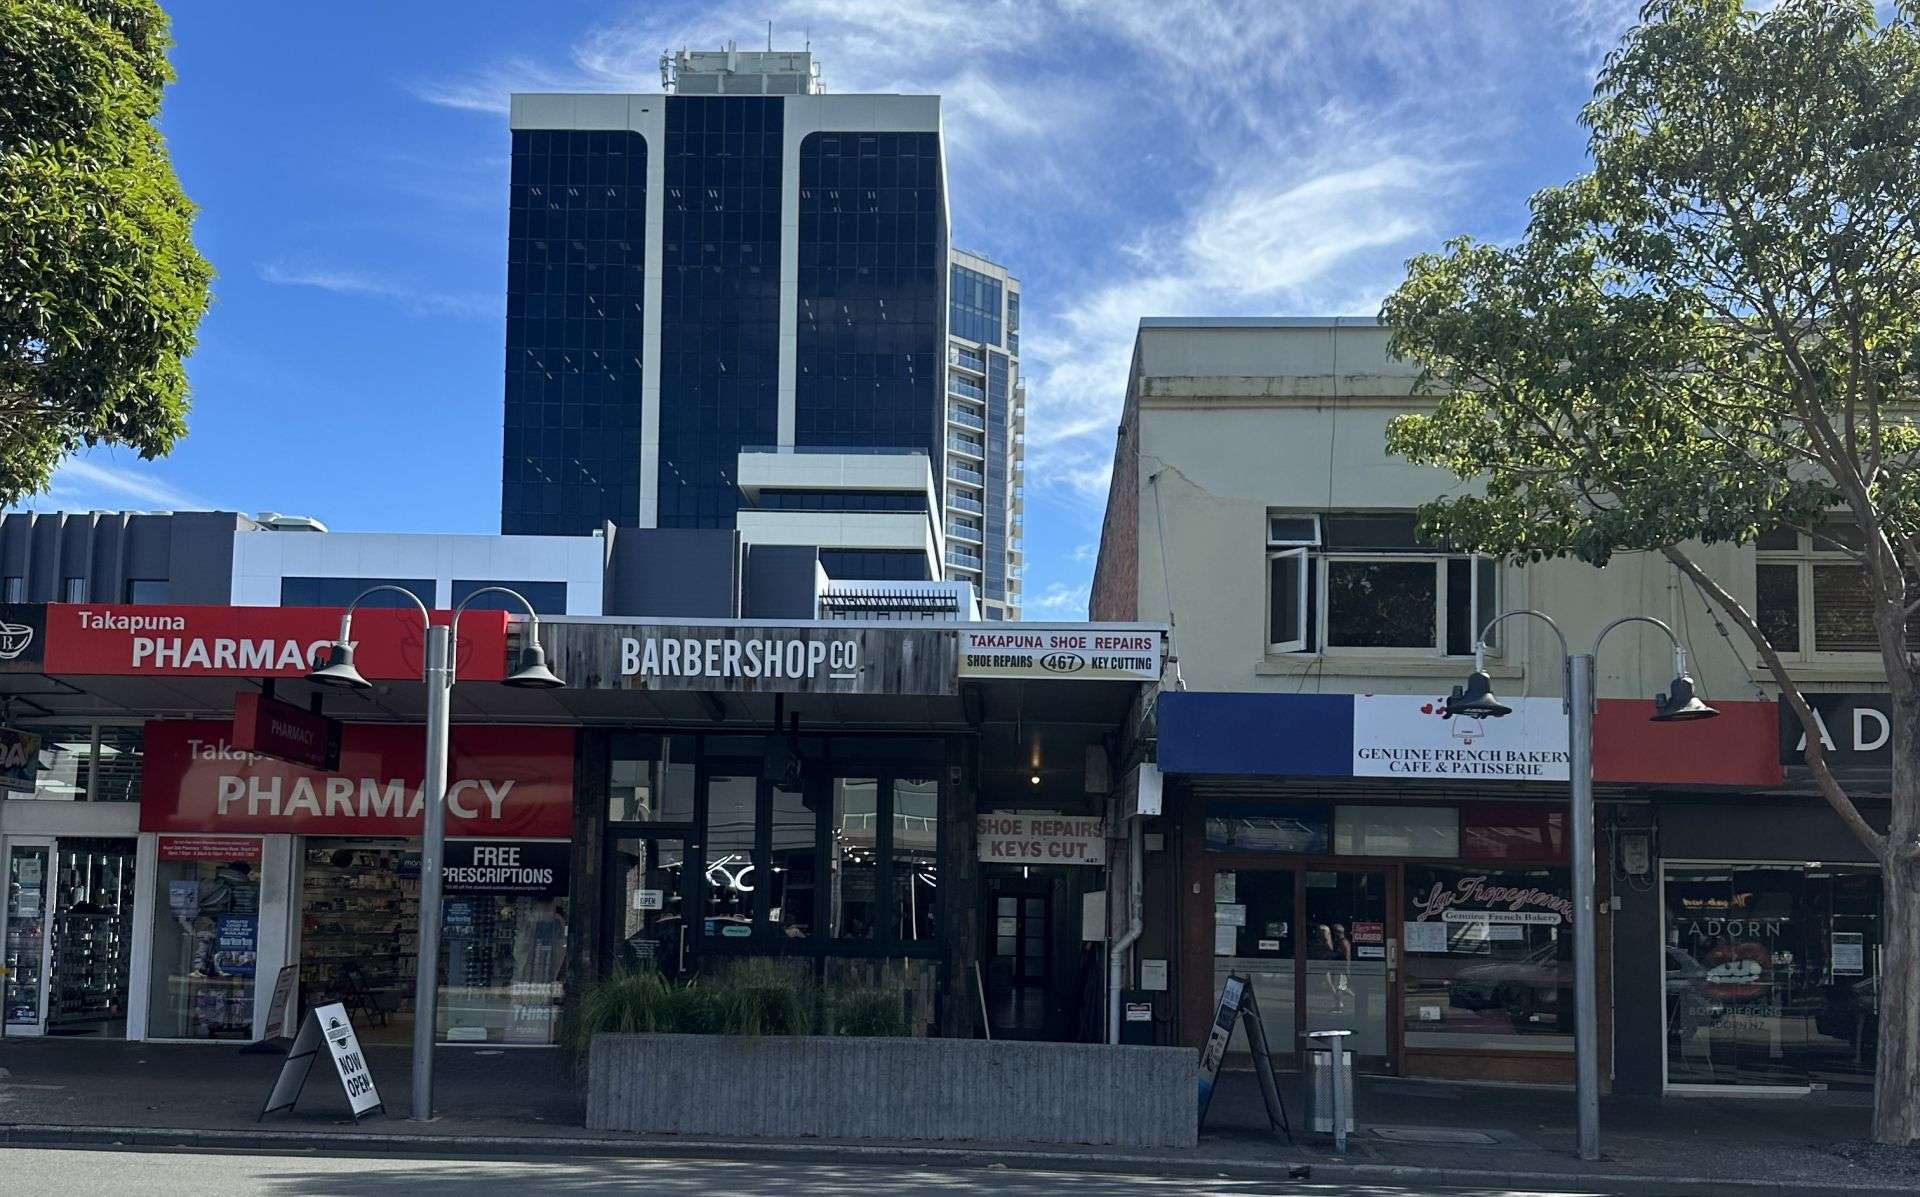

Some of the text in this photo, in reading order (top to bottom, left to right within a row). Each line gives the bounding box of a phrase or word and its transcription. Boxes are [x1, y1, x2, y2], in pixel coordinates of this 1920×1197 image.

[78, 611, 186, 633] Takapuna
[969, 634, 1152, 650] TAKAPUNA SHOE REPAIRS
[621, 637, 857, 679] BARBERSHOP CO
[967, 654, 1152, 670] SHOE REPAIRS 467 KEY CUTTING
[271, 719, 314, 745] PHARMACY
[1358, 748, 1570, 764] GENUINE FRENCH BAKERY
[1389, 760, 1544, 776] CAFE & PATISSERIE
[977, 818, 1104, 838] SHOE REPAIRS
[473, 846, 521, 866] FREE
[991, 841, 1088, 858] KEYS CUT
[442, 868, 553, 884] PRESCRIPTIONS
[640, 897, 656, 905] OPEN
[1413, 882, 1456, 922] La
[1445, 911, 1558, 922] Genuine French Bakery
[1688, 921, 1780, 937] ADORN
[1689, 1007, 1783, 1017] BODY PIERCING
[338, 1051, 364, 1076] NOW
[346, 1073, 373, 1098] OPEN
